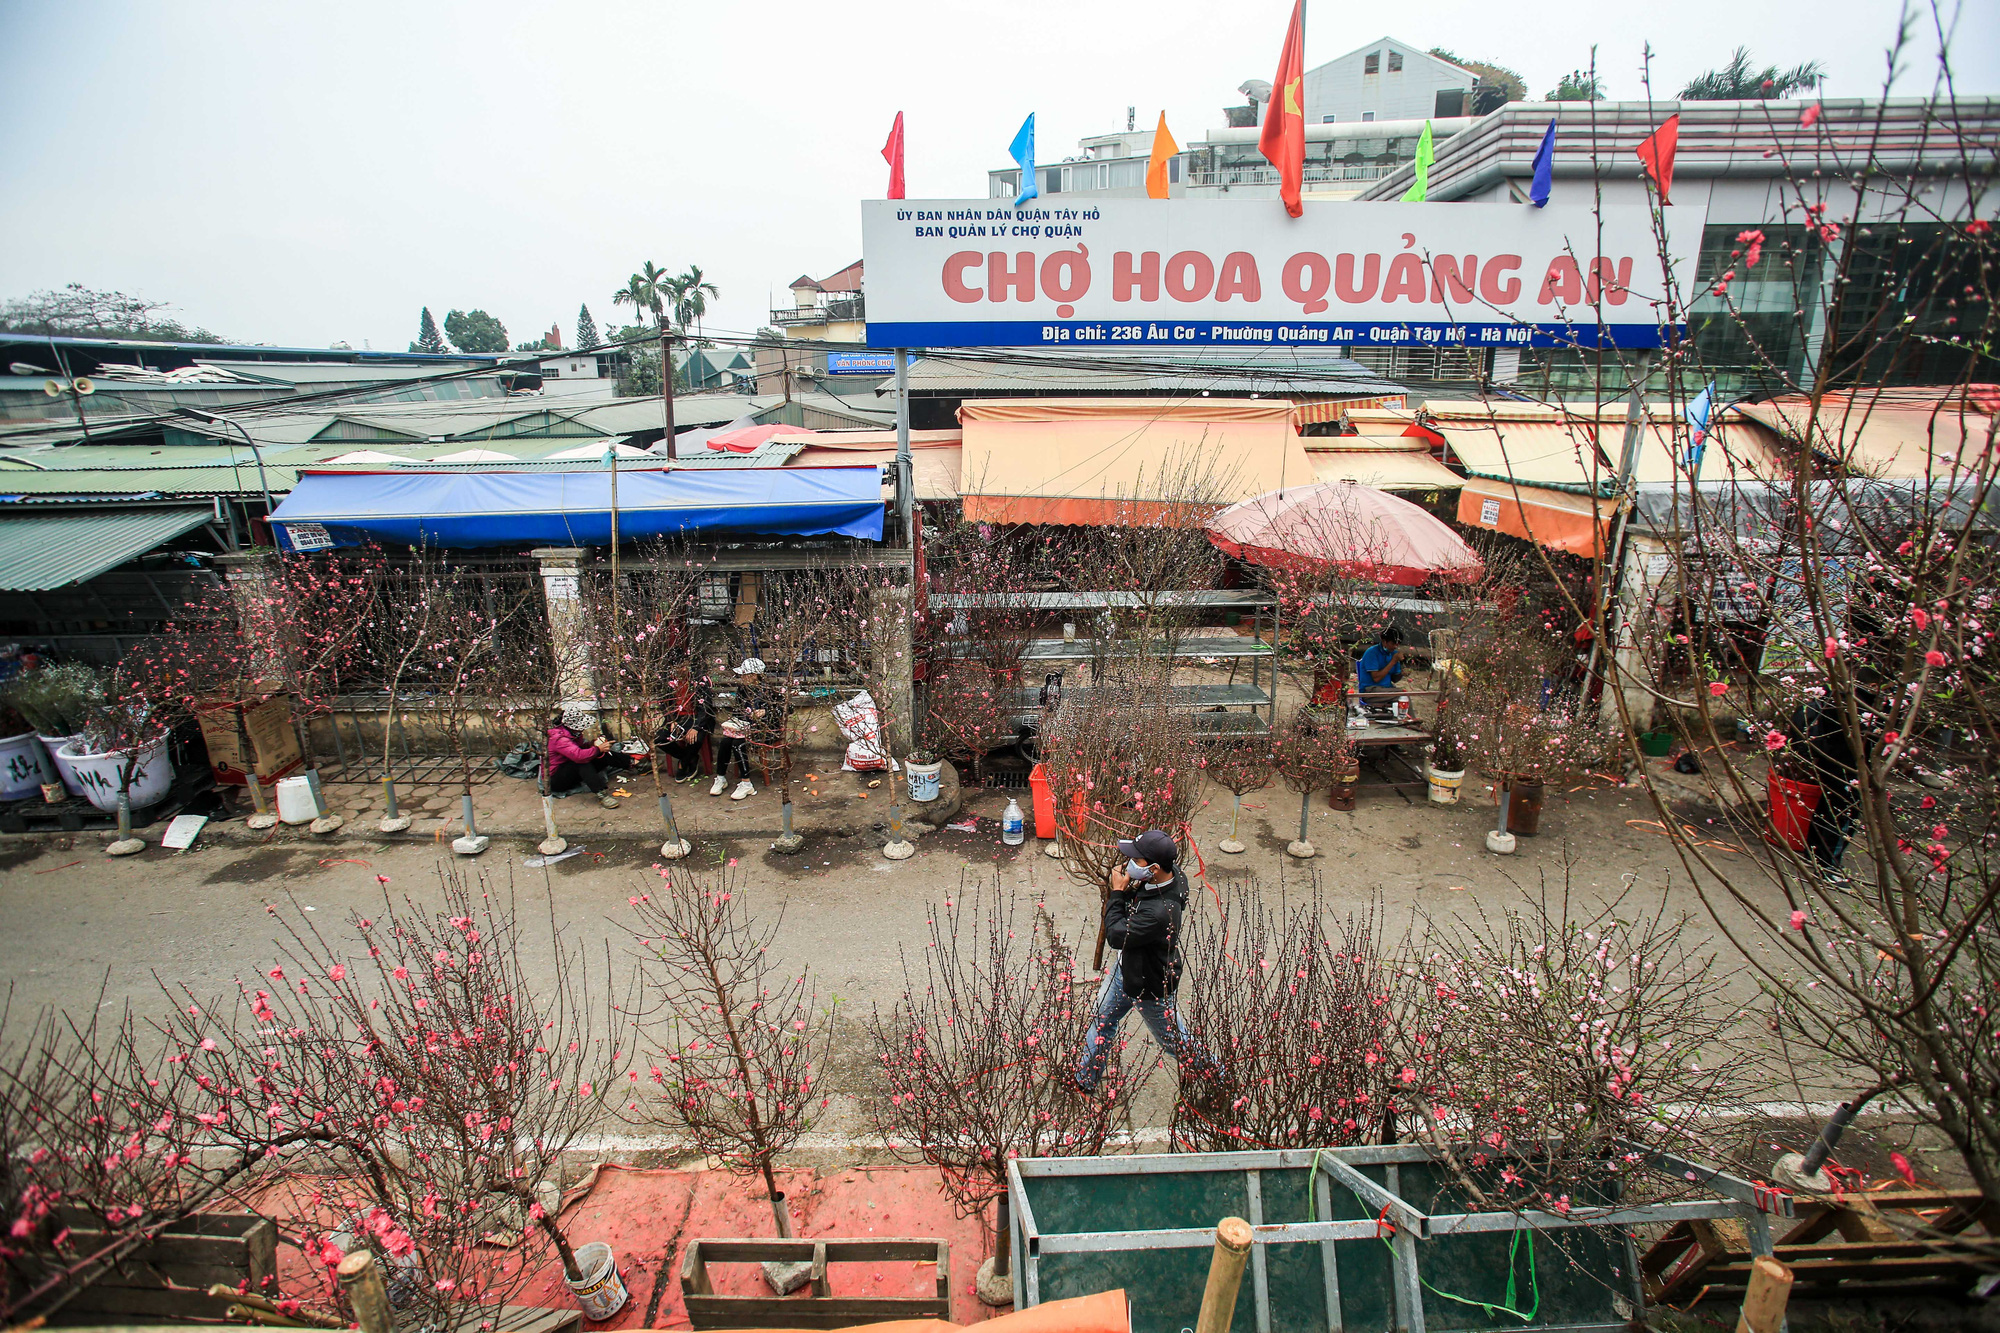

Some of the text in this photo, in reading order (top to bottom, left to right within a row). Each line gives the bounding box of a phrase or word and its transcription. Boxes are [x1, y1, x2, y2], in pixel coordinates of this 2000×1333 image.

[897, 206, 1100, 223] ỦY BAN NHÂN DÂN QUẬN TÂY HỒ
[915, 223, 1082, 239] BAN QUẢN LÝ CHỢ QUẬN
[941, 232, 1634, 319] CHỢ HOA QUẢNG AN
[1042, 326, 1070, 343] Địa
[1075, 324, 1106, 340] chỉ:
[1111, 326, 1142, 340] 236
[1147, 323, 1169, 340] Âu
[1174, 326, 1196, 340] Cơ
[1211, 326, 1273, 342] Phường
[1277, 325, 1328, 342] Quảng
[1332, 327, 1354, 340] An
[1369, 326, 1410, 343] Quận
[1414, 327, 1441, 342] Tây
[1445, 325, 1467, 341] Hồ
[1480, 327, 1501, 341] Hà
[1505, 327, 1532, 344] Nội
[852, 358, 876, 367] PHÒNG
[877, 359, 891, 368] CHỢ
